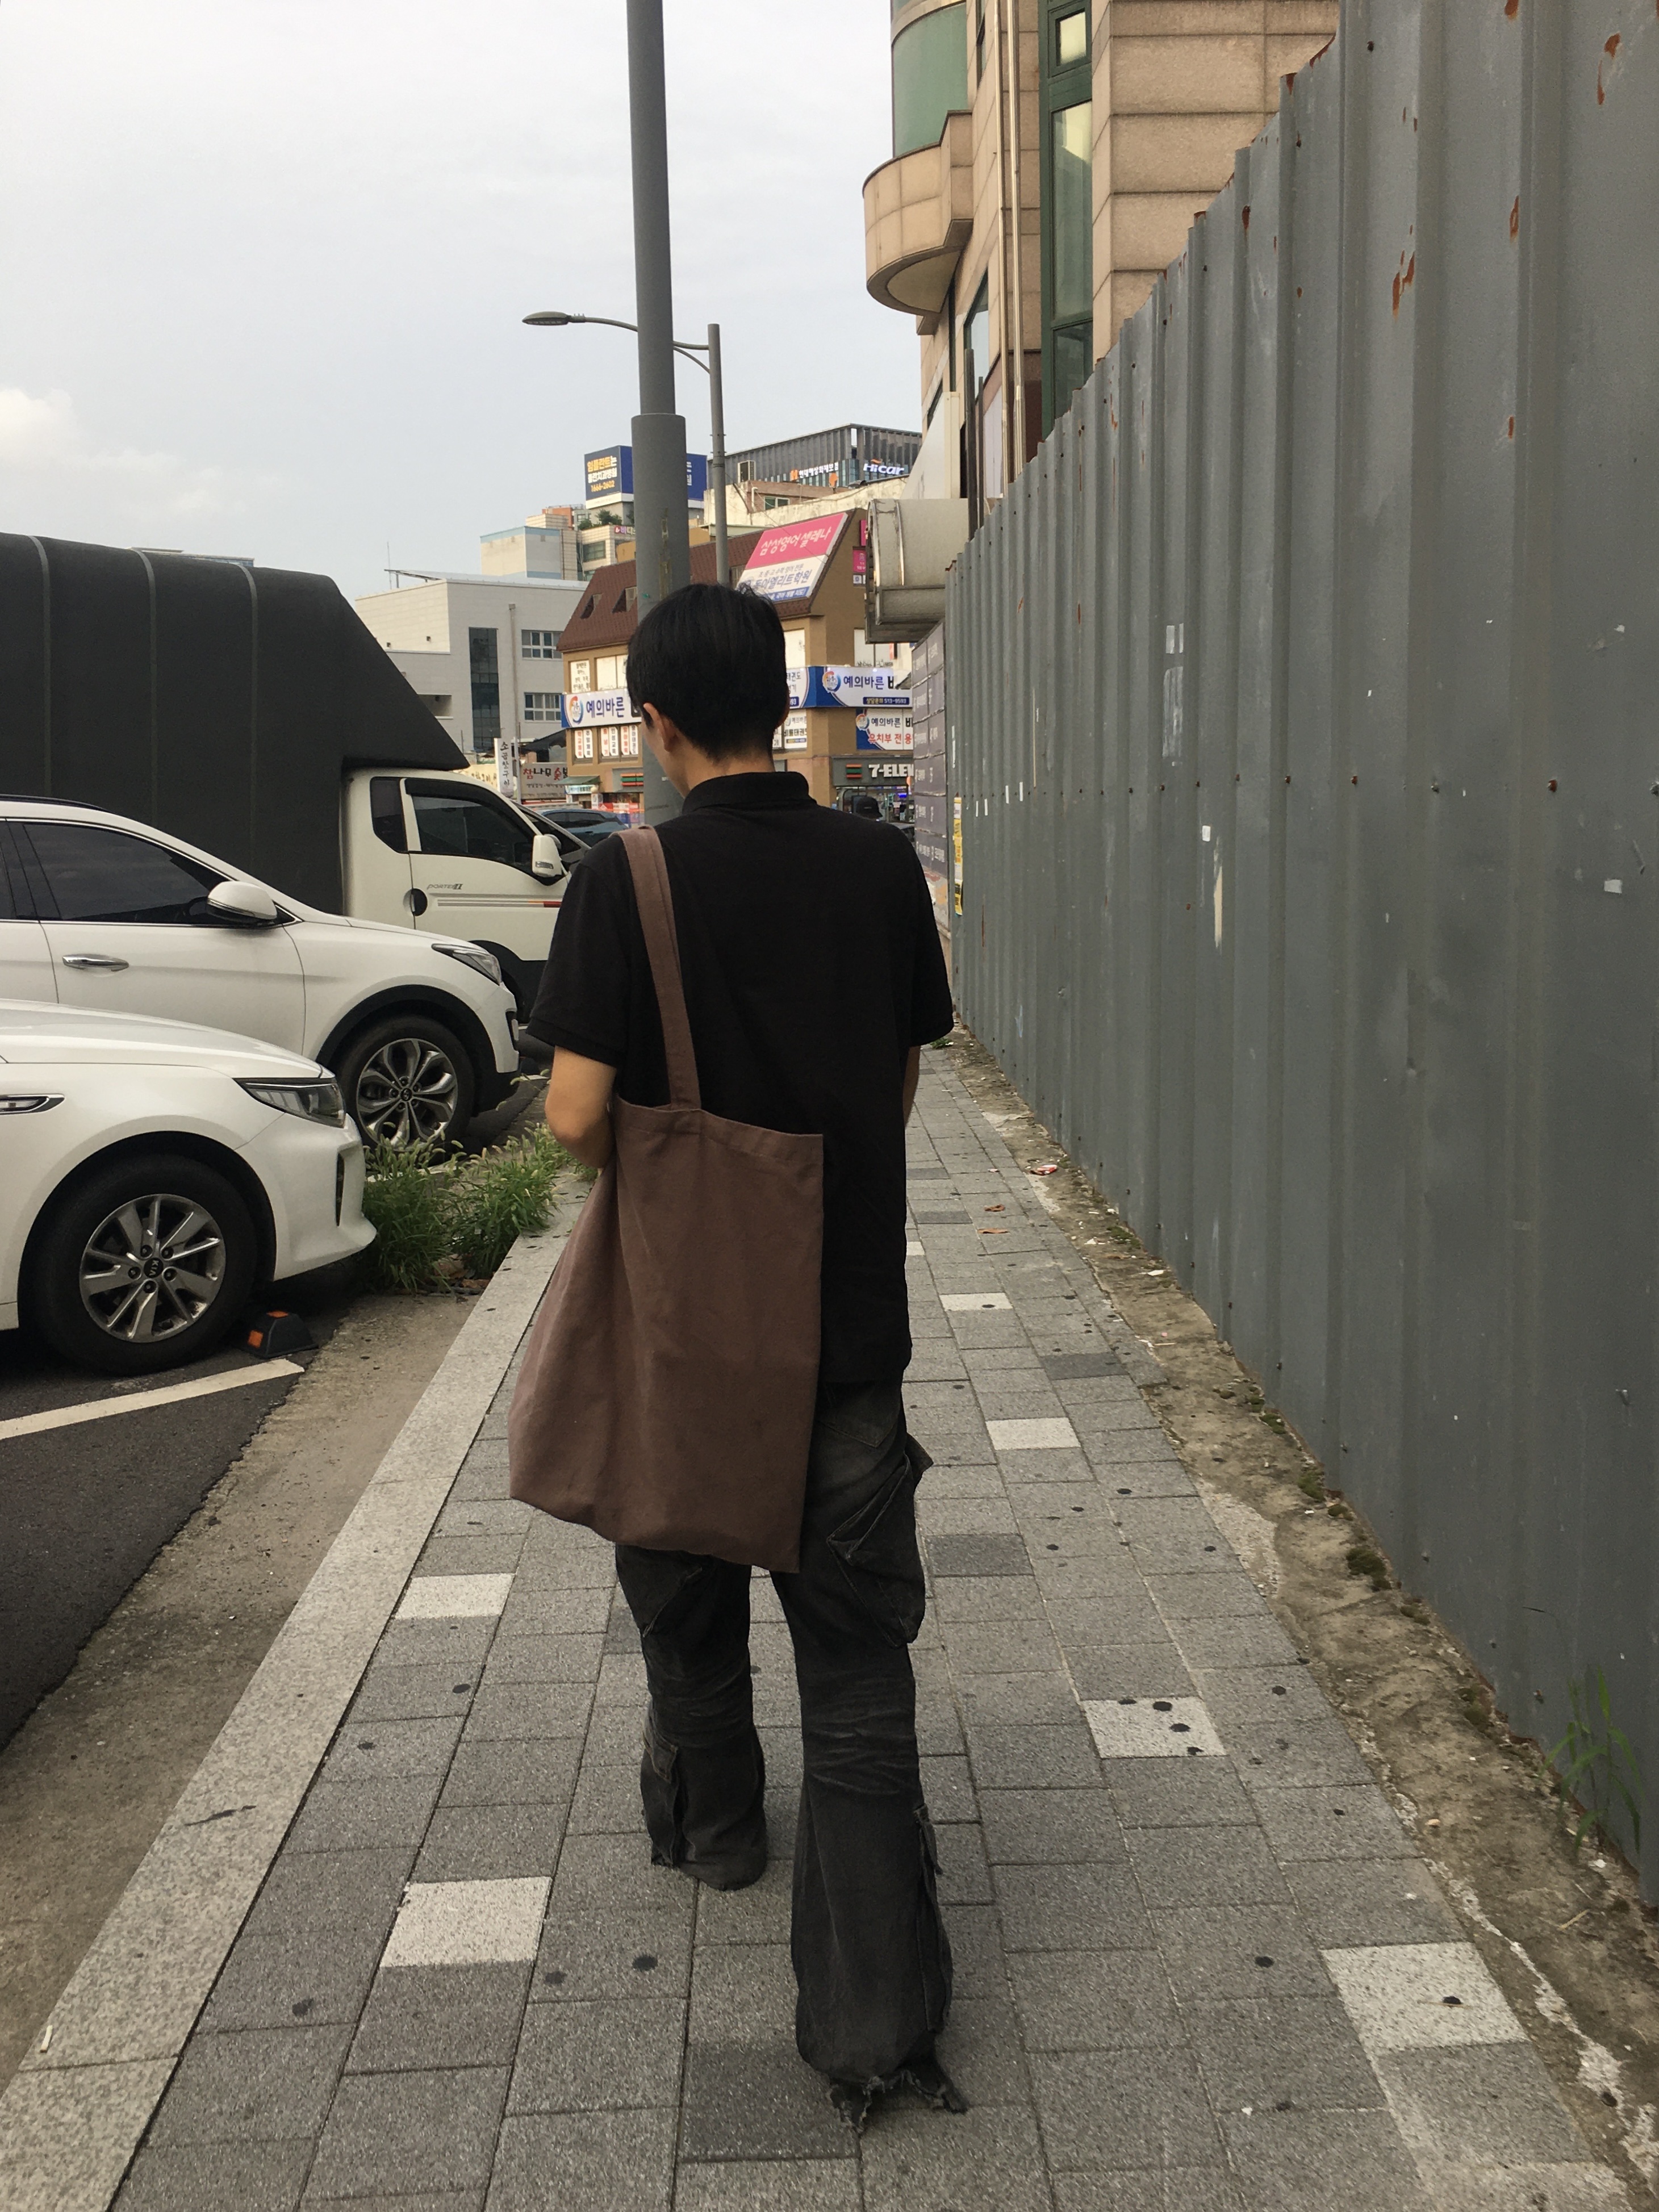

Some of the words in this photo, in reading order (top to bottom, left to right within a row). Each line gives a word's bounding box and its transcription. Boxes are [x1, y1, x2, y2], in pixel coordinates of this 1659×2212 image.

[587, 455, 617, 472] 임플란트는
[863, 463, 904, 475] Hicar
[843, 676, 884, 690] 예의바른
[586, 697, 625, 718] 예의바른
[871, 718, 901, 727] 예의바른
[869, 734, 892, 743] 유치부
[523, 767, 551, 779] 참나무
